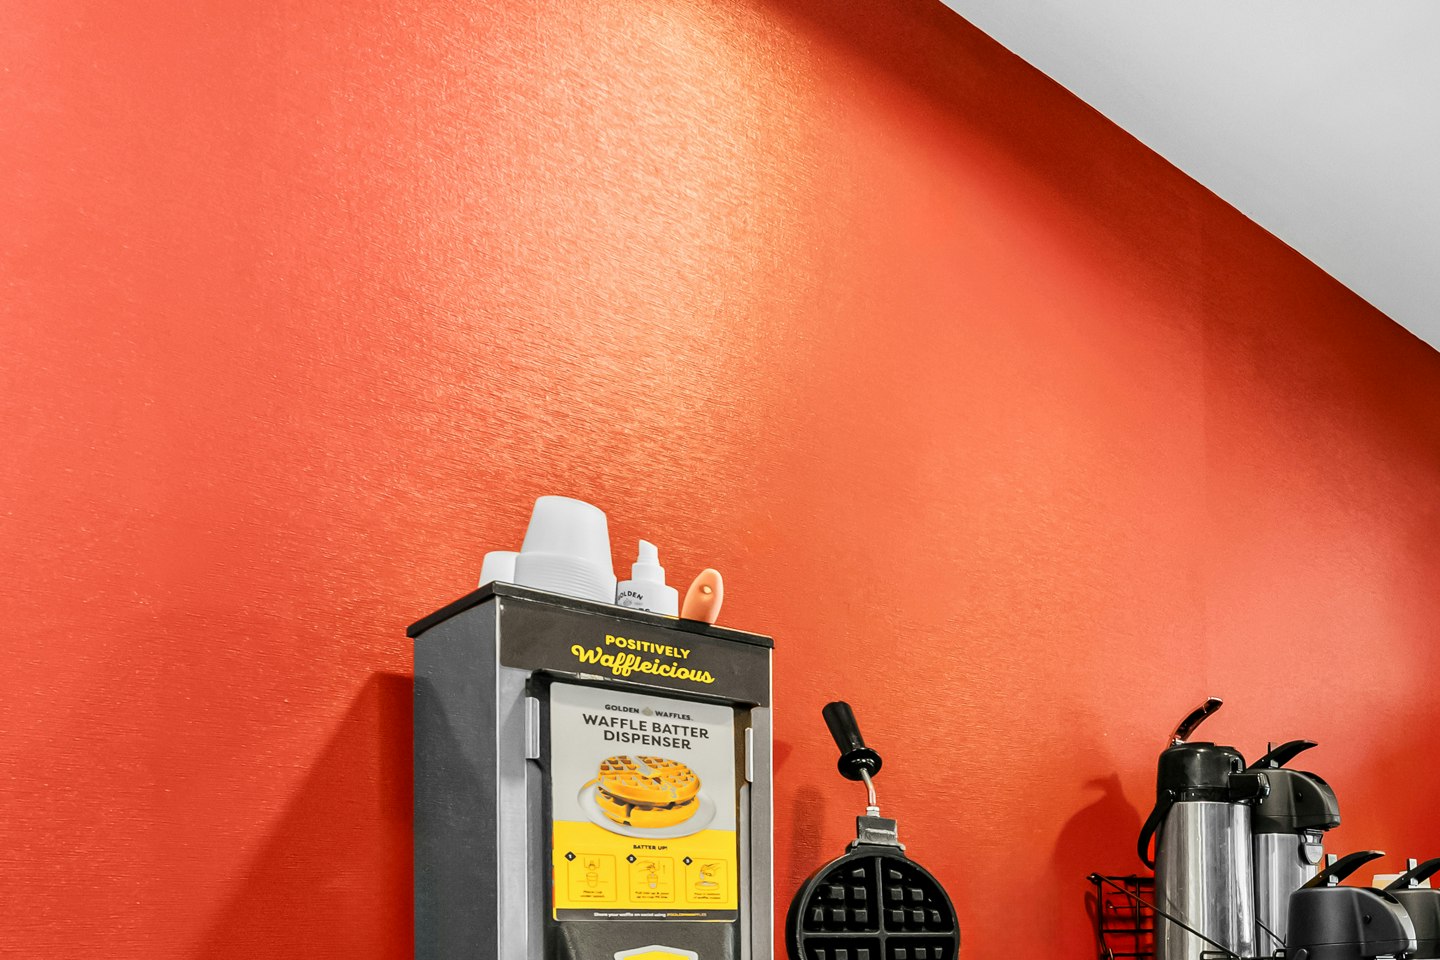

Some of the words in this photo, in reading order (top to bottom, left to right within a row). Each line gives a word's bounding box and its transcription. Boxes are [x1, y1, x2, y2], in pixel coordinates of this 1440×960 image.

[605, 634, 691, 659] POSITIVELY
[571, 644, 716, 684] Waffleicious
[605, 704, 640, 714] GOLDEN
[655, 710, 691, 721] WAFFLES
[582, 713, 648, 732] WAFFLE
[652, 722, 709, 739] BATTER
[603, 730, 692, 750] DISPENSER
